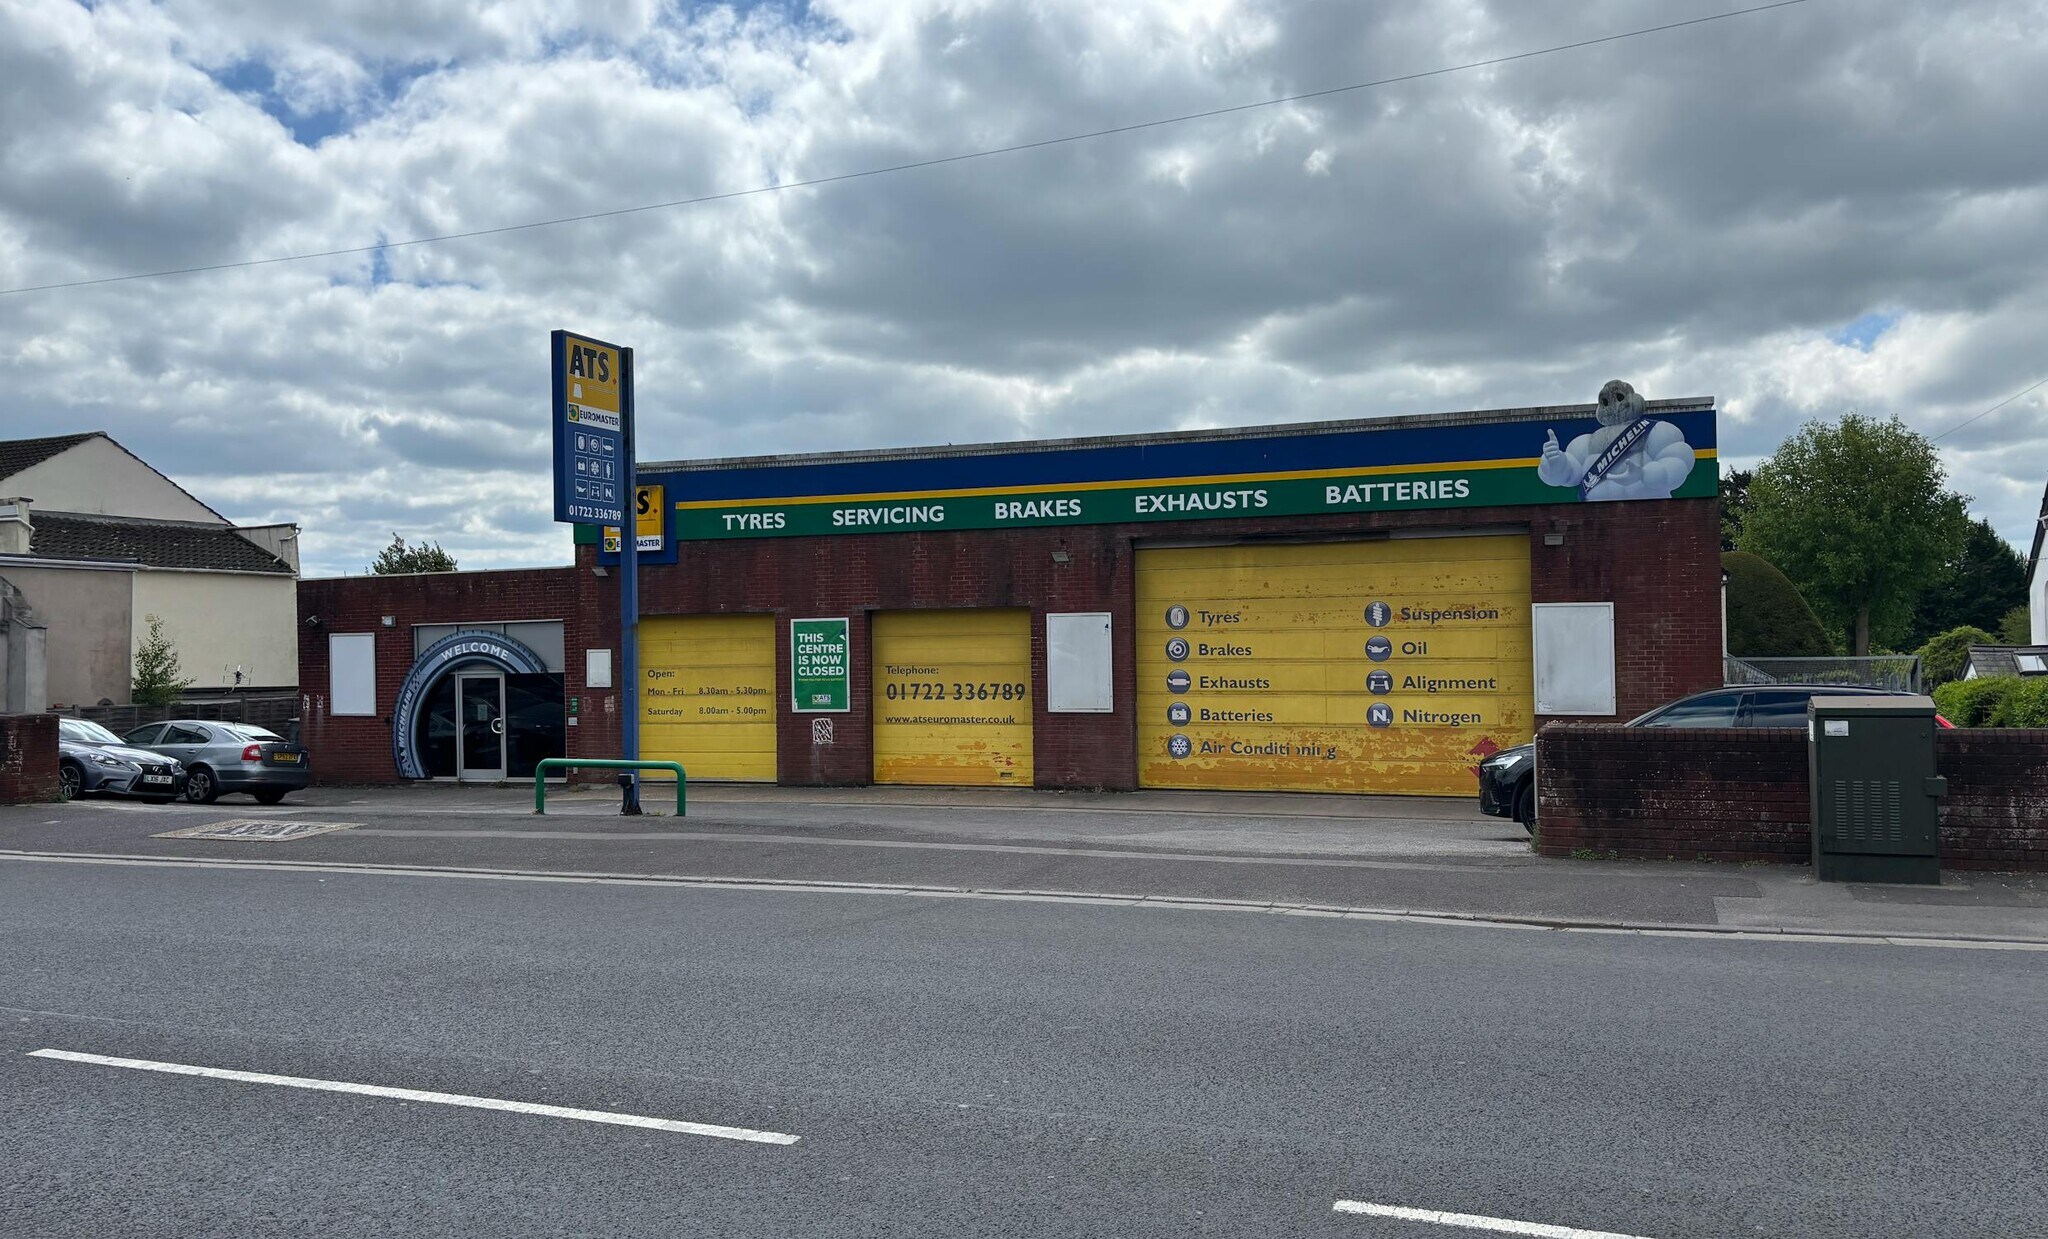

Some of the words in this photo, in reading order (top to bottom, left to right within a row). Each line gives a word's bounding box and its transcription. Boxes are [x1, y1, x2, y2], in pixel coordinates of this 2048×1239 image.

[569, 344, 609, 383] ATS
[579, 410, 619, 426] EUROMASTER
[1597, 419, 1650, 473] MICHELIN
[722, 512, 786, 531] TYRES
[832, 505, 945, 527] SERVICING
[994, 499, 1082, 520] BRAKES
[1135, 489, 1268, 513] EXHAUSTS
[1325, 479, 1470, 504] BATTERIES
[569, 504, 593, 518] 01722
[594, 507, 622, 521] 336789
[1198, 611, 1240, 627] Tyres
[1400, 607, 1499, 624] Suspension
[797, 633, 824, 643] THIS
[441, 642, 509, 661] WELCOME
[798, 644, 844, 654] CENTRE
[1198, 643, 1252, 656] Brakes
[1401, 641, 1427, 655] Oil
[798, 655, 809, 665] IS
[812, 655, 842, 665] NOW
[647, 669, 675, 679] Open:
[798, 666, 845, 676] CLOSED
[885, 665, 939, 676] Telephone:
[1200, 676, 1270, 689] Exhausts
[1402, 675, 1497, 693] Alignment
[648, 687, 666, 696] Mon
[673, 687, 684, 696] Fri
[698, 686, 728, 695] 8.30am
[736, 686, 767, 697] 5.30pm
[886, 683, 946, 700] 01722
[952, 683, 1026, 700] 336789
[398, 689, 413, 748] MICHELIN
[647, 707, 683, 717] Saturday
[698, 706, 729, 715] 8.00am
[736, 706, 767, 716] 5.00pm
[1200, 708, 1273, 722] Batteries
[1403, 709, 1482, 726] Nitrogen
[885, 715, 1015, 724] www.atseuromaster.co.uk
[1200, 741, 1225, 754] Air
